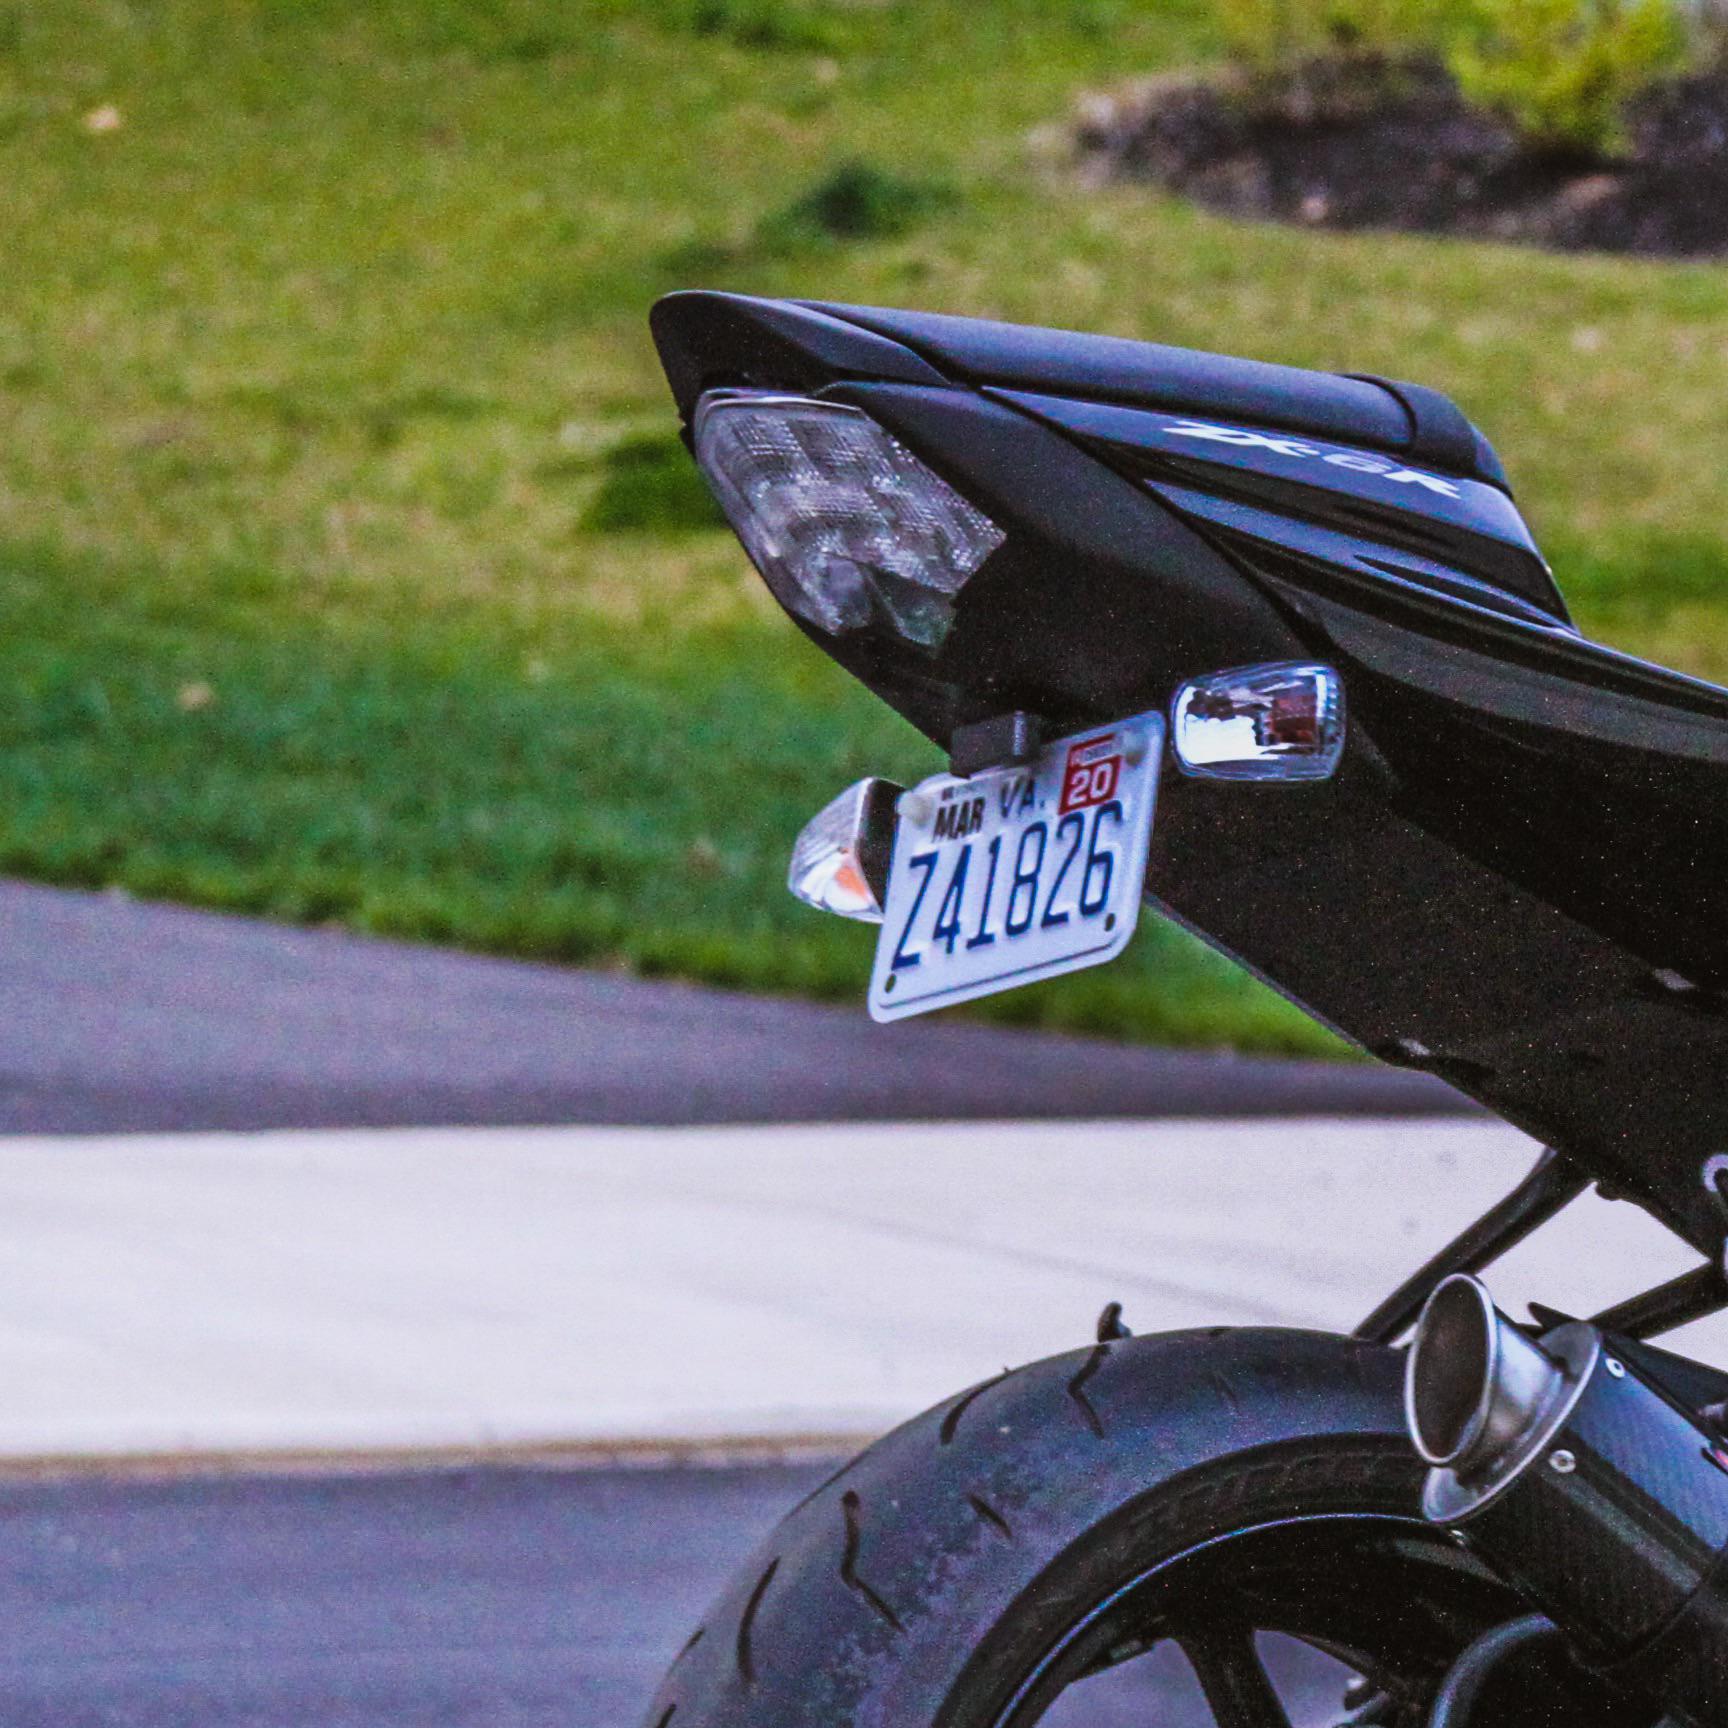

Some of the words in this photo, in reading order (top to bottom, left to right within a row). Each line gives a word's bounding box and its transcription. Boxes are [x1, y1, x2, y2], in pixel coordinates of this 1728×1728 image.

[1070, 763, 1113, 806] 20
[933, 797, 986, 842] MAR
[891, 800, 1123, 970] Z41826
